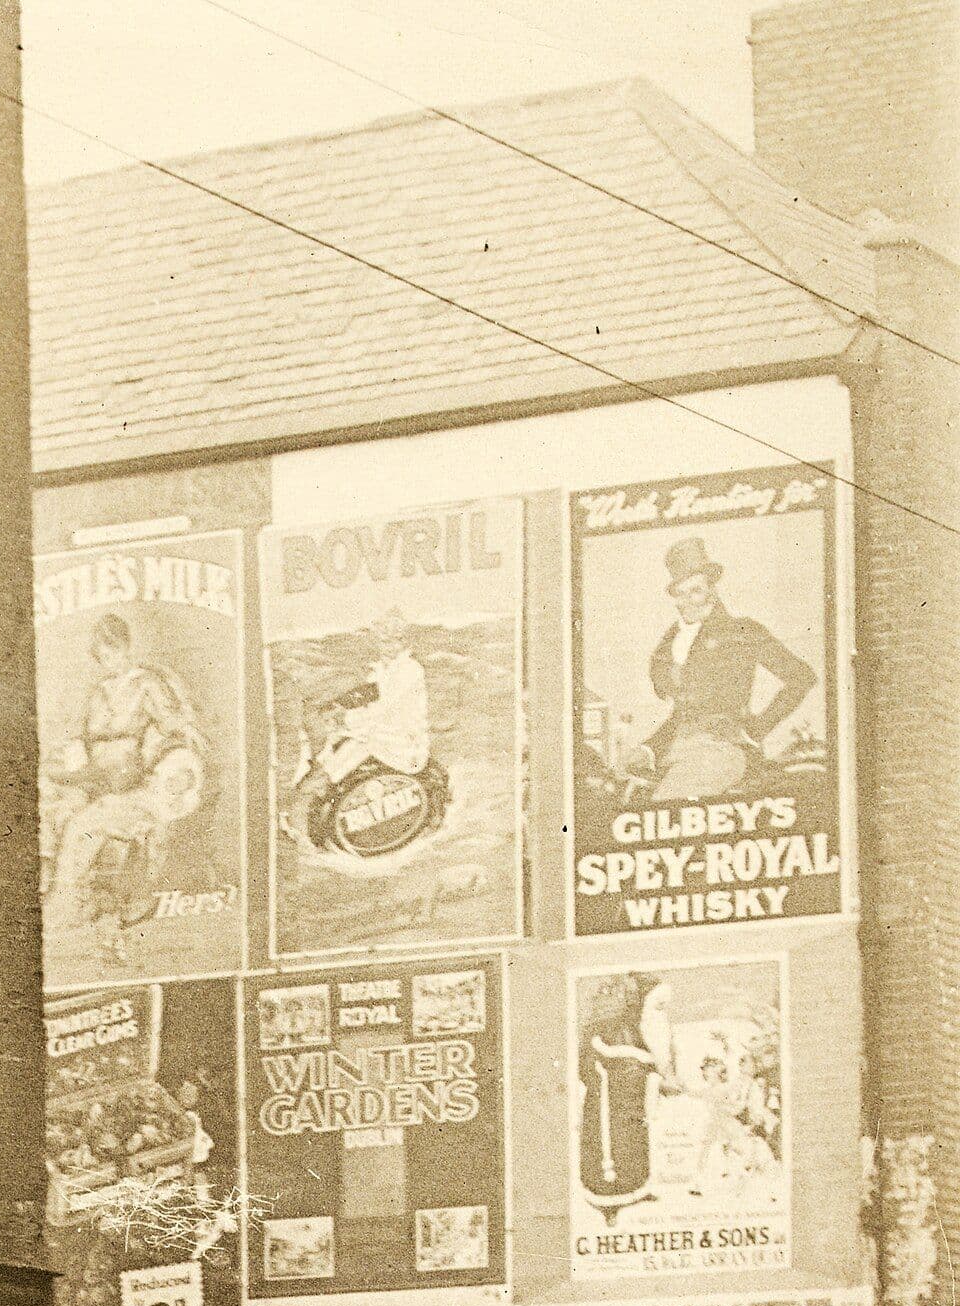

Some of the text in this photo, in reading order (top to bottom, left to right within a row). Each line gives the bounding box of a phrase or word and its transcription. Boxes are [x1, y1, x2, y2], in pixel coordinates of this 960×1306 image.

[282, 512, 502, 594] BOVRIL
[143, 555, 235, 618] MILK
[611, 797, 797, 843] GILBEY'S
[577, 832, 839, 896] SPEY-ROYAL
[624, 885, 790, 928] WHISKY
[339, 1004, 402, 1028] ROYAL
[261, 1041, 477, 1094] WINTER
[259, 1080, 481, 1135] GARDENS
[596, 1230, 695, 1256] HEATHER
[699, 1230, 712, 1249] &
[718, 1226, 770, 1248] SONS
